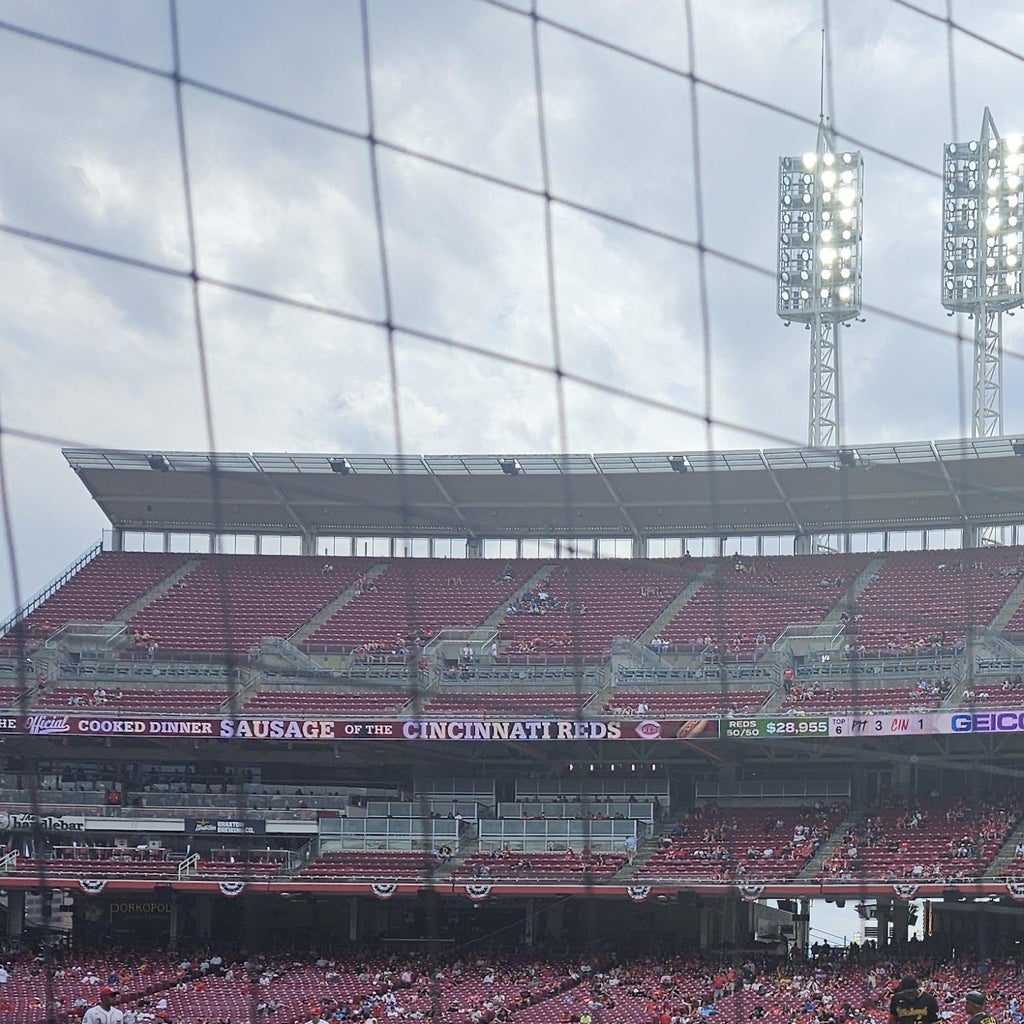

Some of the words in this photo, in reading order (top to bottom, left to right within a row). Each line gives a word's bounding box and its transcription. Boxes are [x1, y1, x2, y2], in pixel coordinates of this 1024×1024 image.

[25, 714, 71, 735] Official
[78, 720, 145, 733] COOKED
[150, 721, 213, 734] DINNER
[220, 720, 335, 739] SAUSAGE
[344, 725, 361, 735] OF
[366, 725, 393, 735] THE
[402, 722, 550, 739] CINCINNATI
[557, 722, 621, 739] REDS
[729, 720, 757, 728] REDS
[766, 721, 828, 735] $28,955
[835, 726, 842, 735] 6
[875, 720, 883, 731] 3
[891, 719, 909, 732] CIN
[917, 719, 924, 730] 1
[726, 729, 759, 737] 50/50
[13, 816, 84, 830] hadlebar
